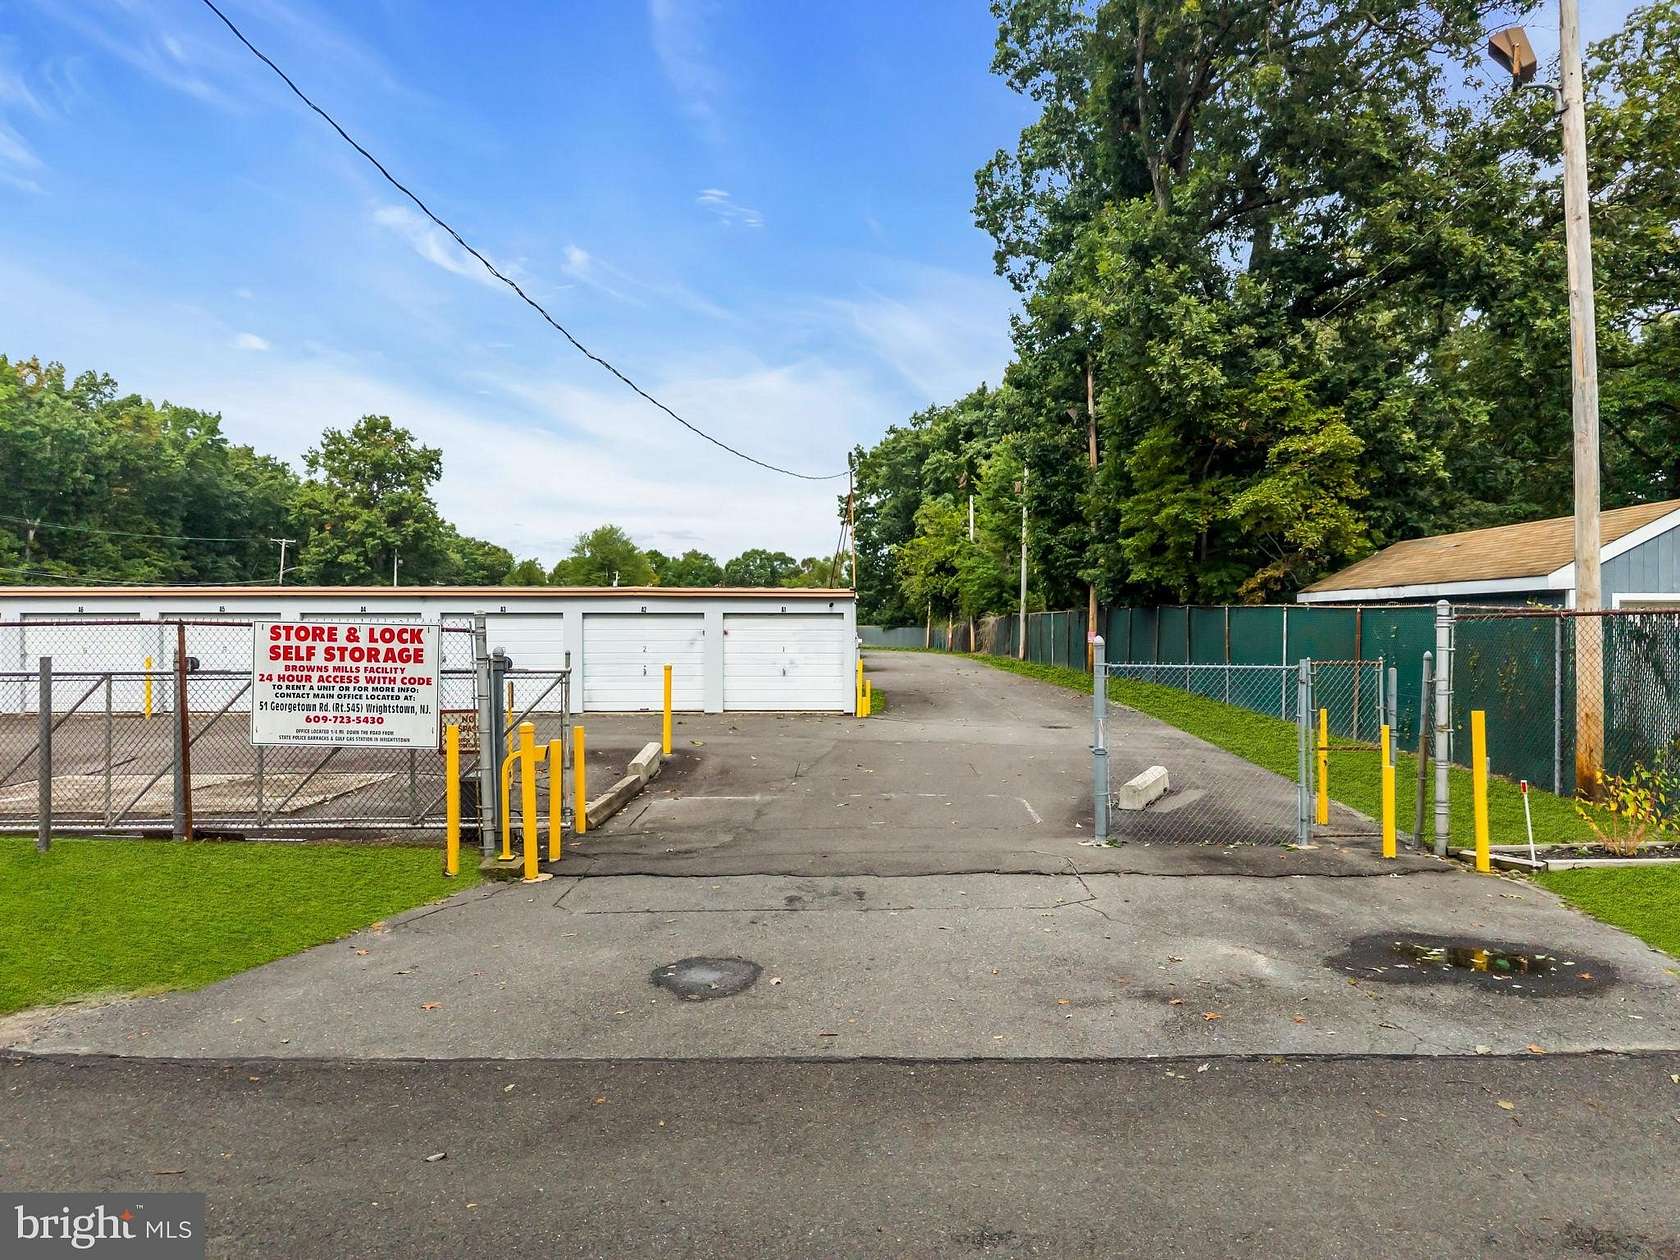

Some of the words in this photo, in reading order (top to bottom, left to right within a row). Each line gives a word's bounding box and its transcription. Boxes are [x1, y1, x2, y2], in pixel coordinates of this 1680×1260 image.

[270, 625, 337, 642] STORE
[345, 627, 360, 642] &
[369, 627, 424, 644] LOCK
[269, 645, 316, 661] SELF
[324, 646, 424, 663] STORAGE
[285, 665, 329, 673] BROWNS
[259, 674, 273, 682] 24
[278, 674, 312, 683] HOUR
[317, 675, 360, 684] ACCESS
[365, 676, 396, 684] WITH
[401, 677, 432, 685] CODE
[260, 701, 268, 711] 51
[271, 701, 317, 713] Georgetown
[319, 702, 331, 712] Rd.
[333, 703, 363, 713] (Rt.545)
[366, 703, 418, 715] Wrightstown,
[420, 704, 431, 714] NJ.
[305, 715, 384, 724] 609-723-5430
